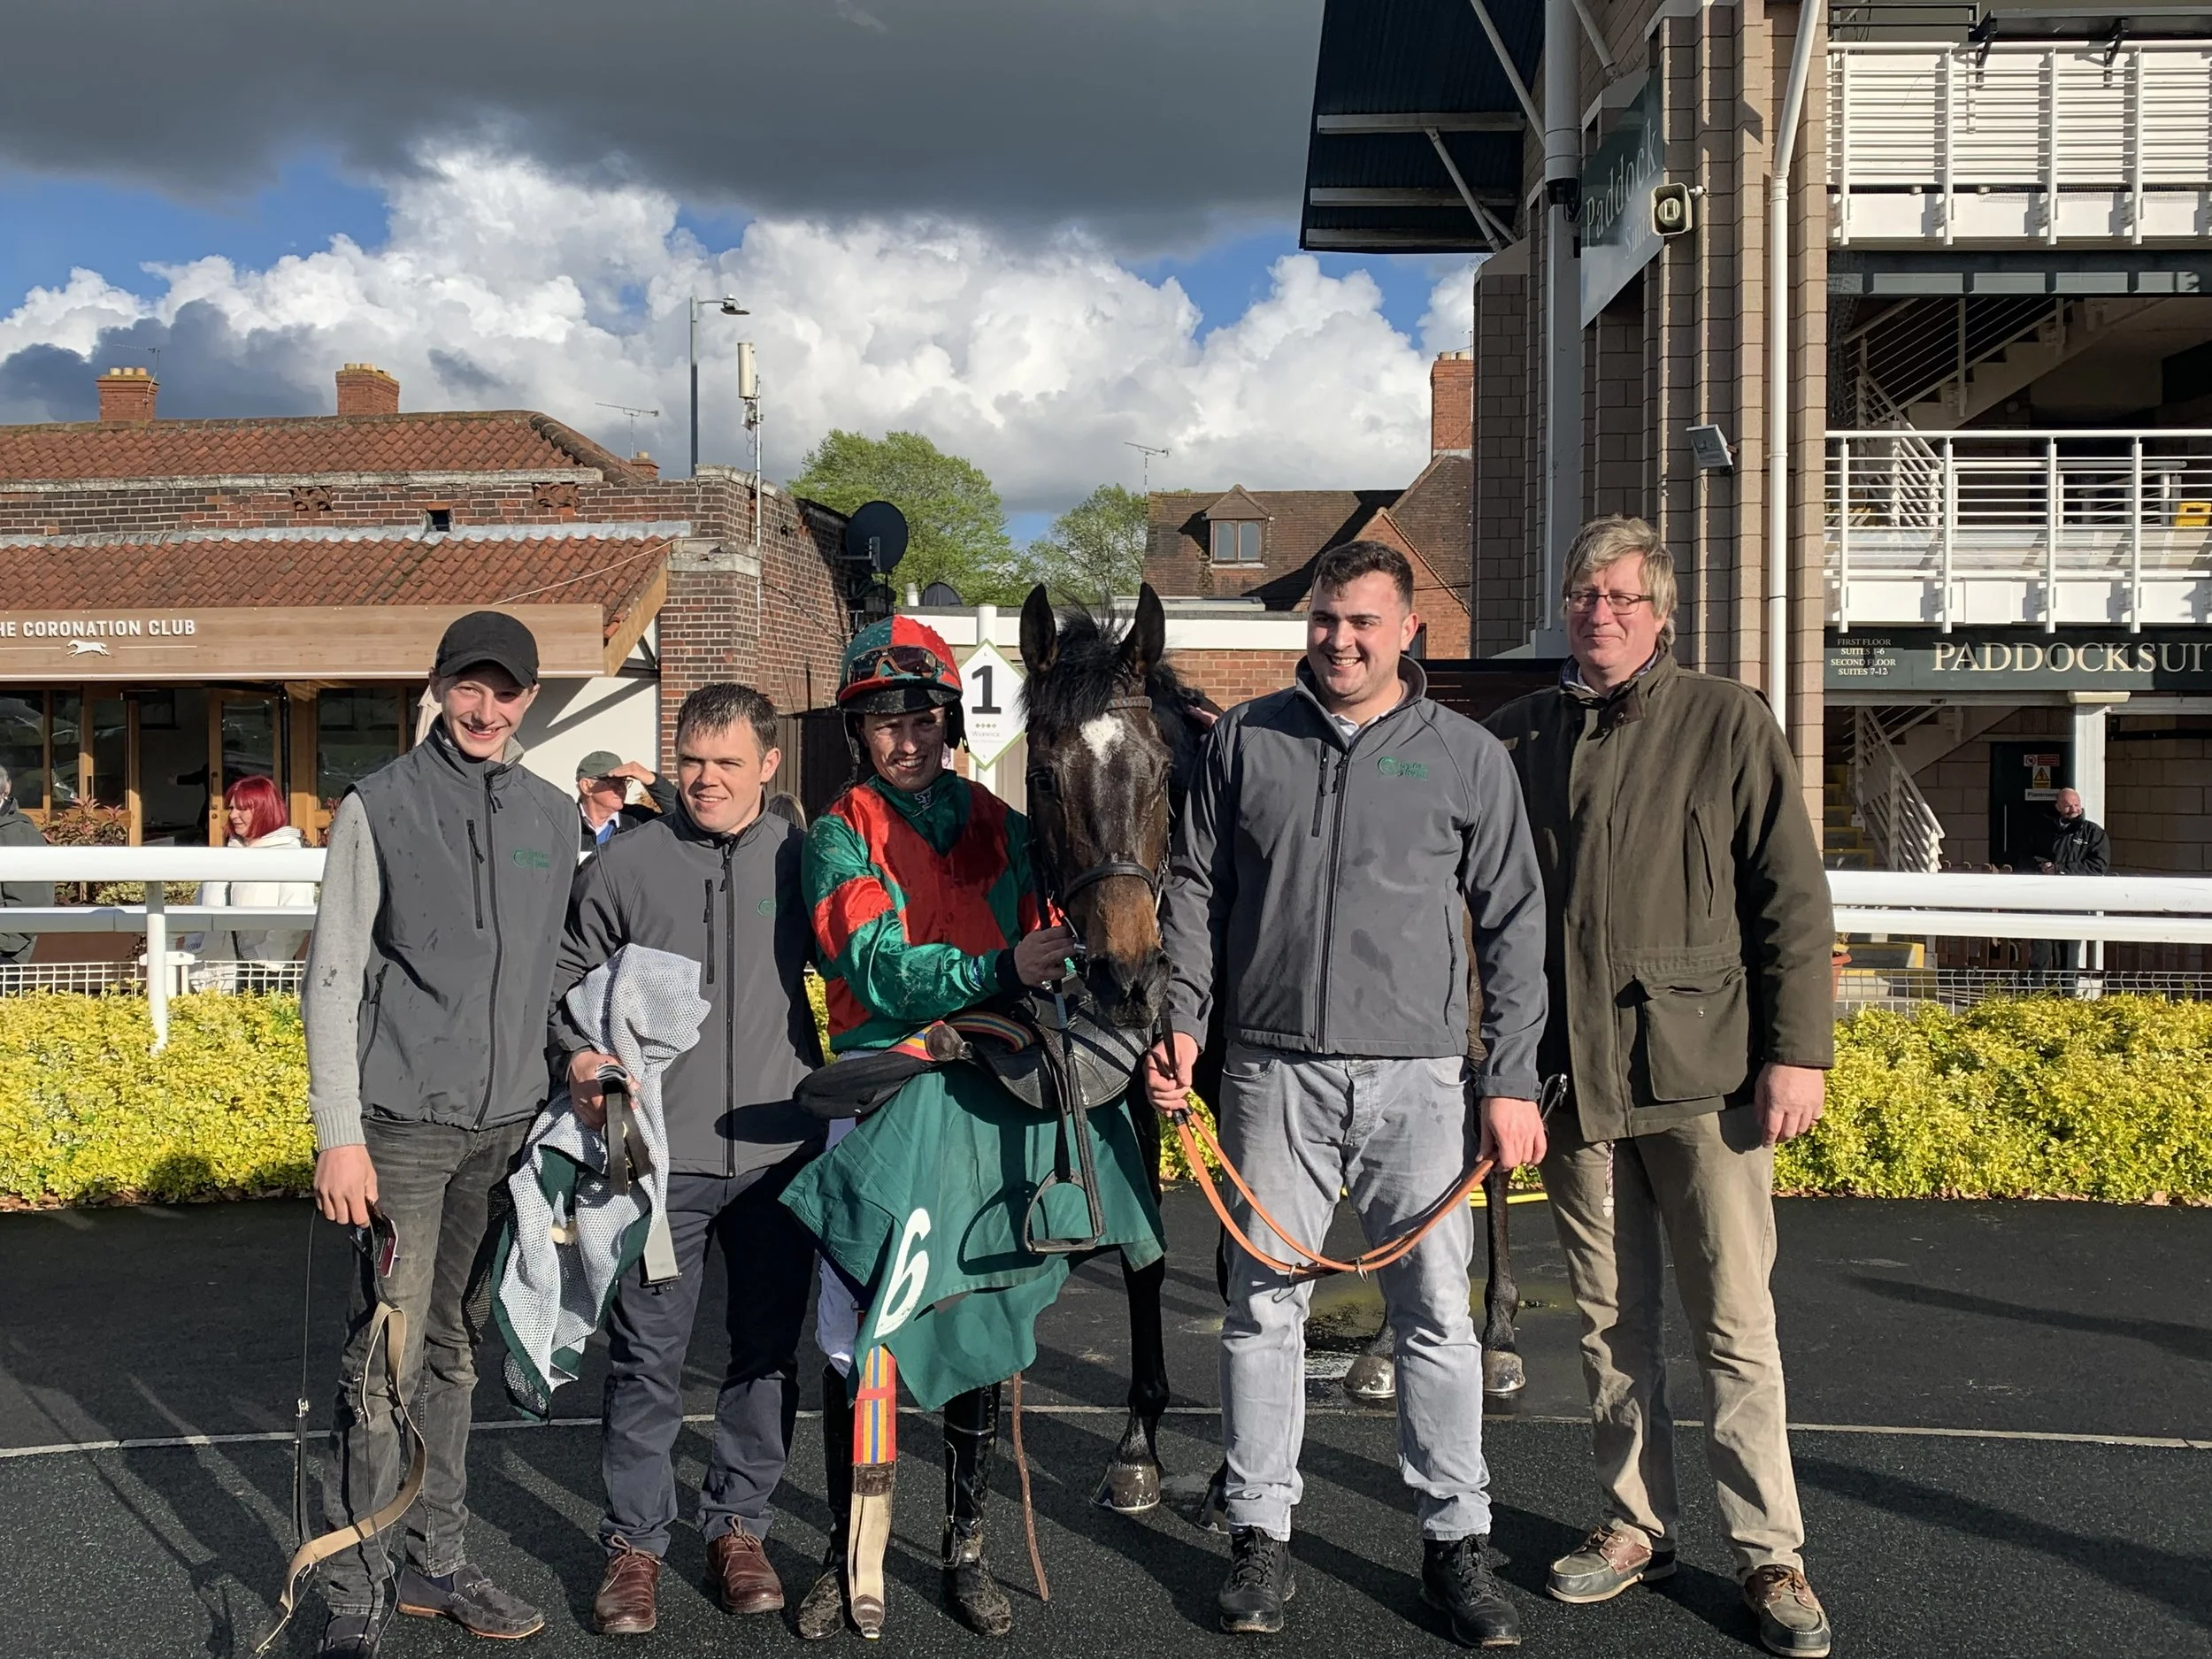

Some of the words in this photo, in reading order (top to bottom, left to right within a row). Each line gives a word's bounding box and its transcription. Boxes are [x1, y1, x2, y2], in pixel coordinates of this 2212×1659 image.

[1586, 117, 1657, 251] Paddock
[1624, 217, 1652, 259] Suite
[23, 620, 142, 637] CORONATION
[148, 619, 196, 636] CLUB
[1932, 641, 2134, 672] PADDOCK
[972, 665, 1002, 714] 1
[872, 1208, 932, 1339] 6
